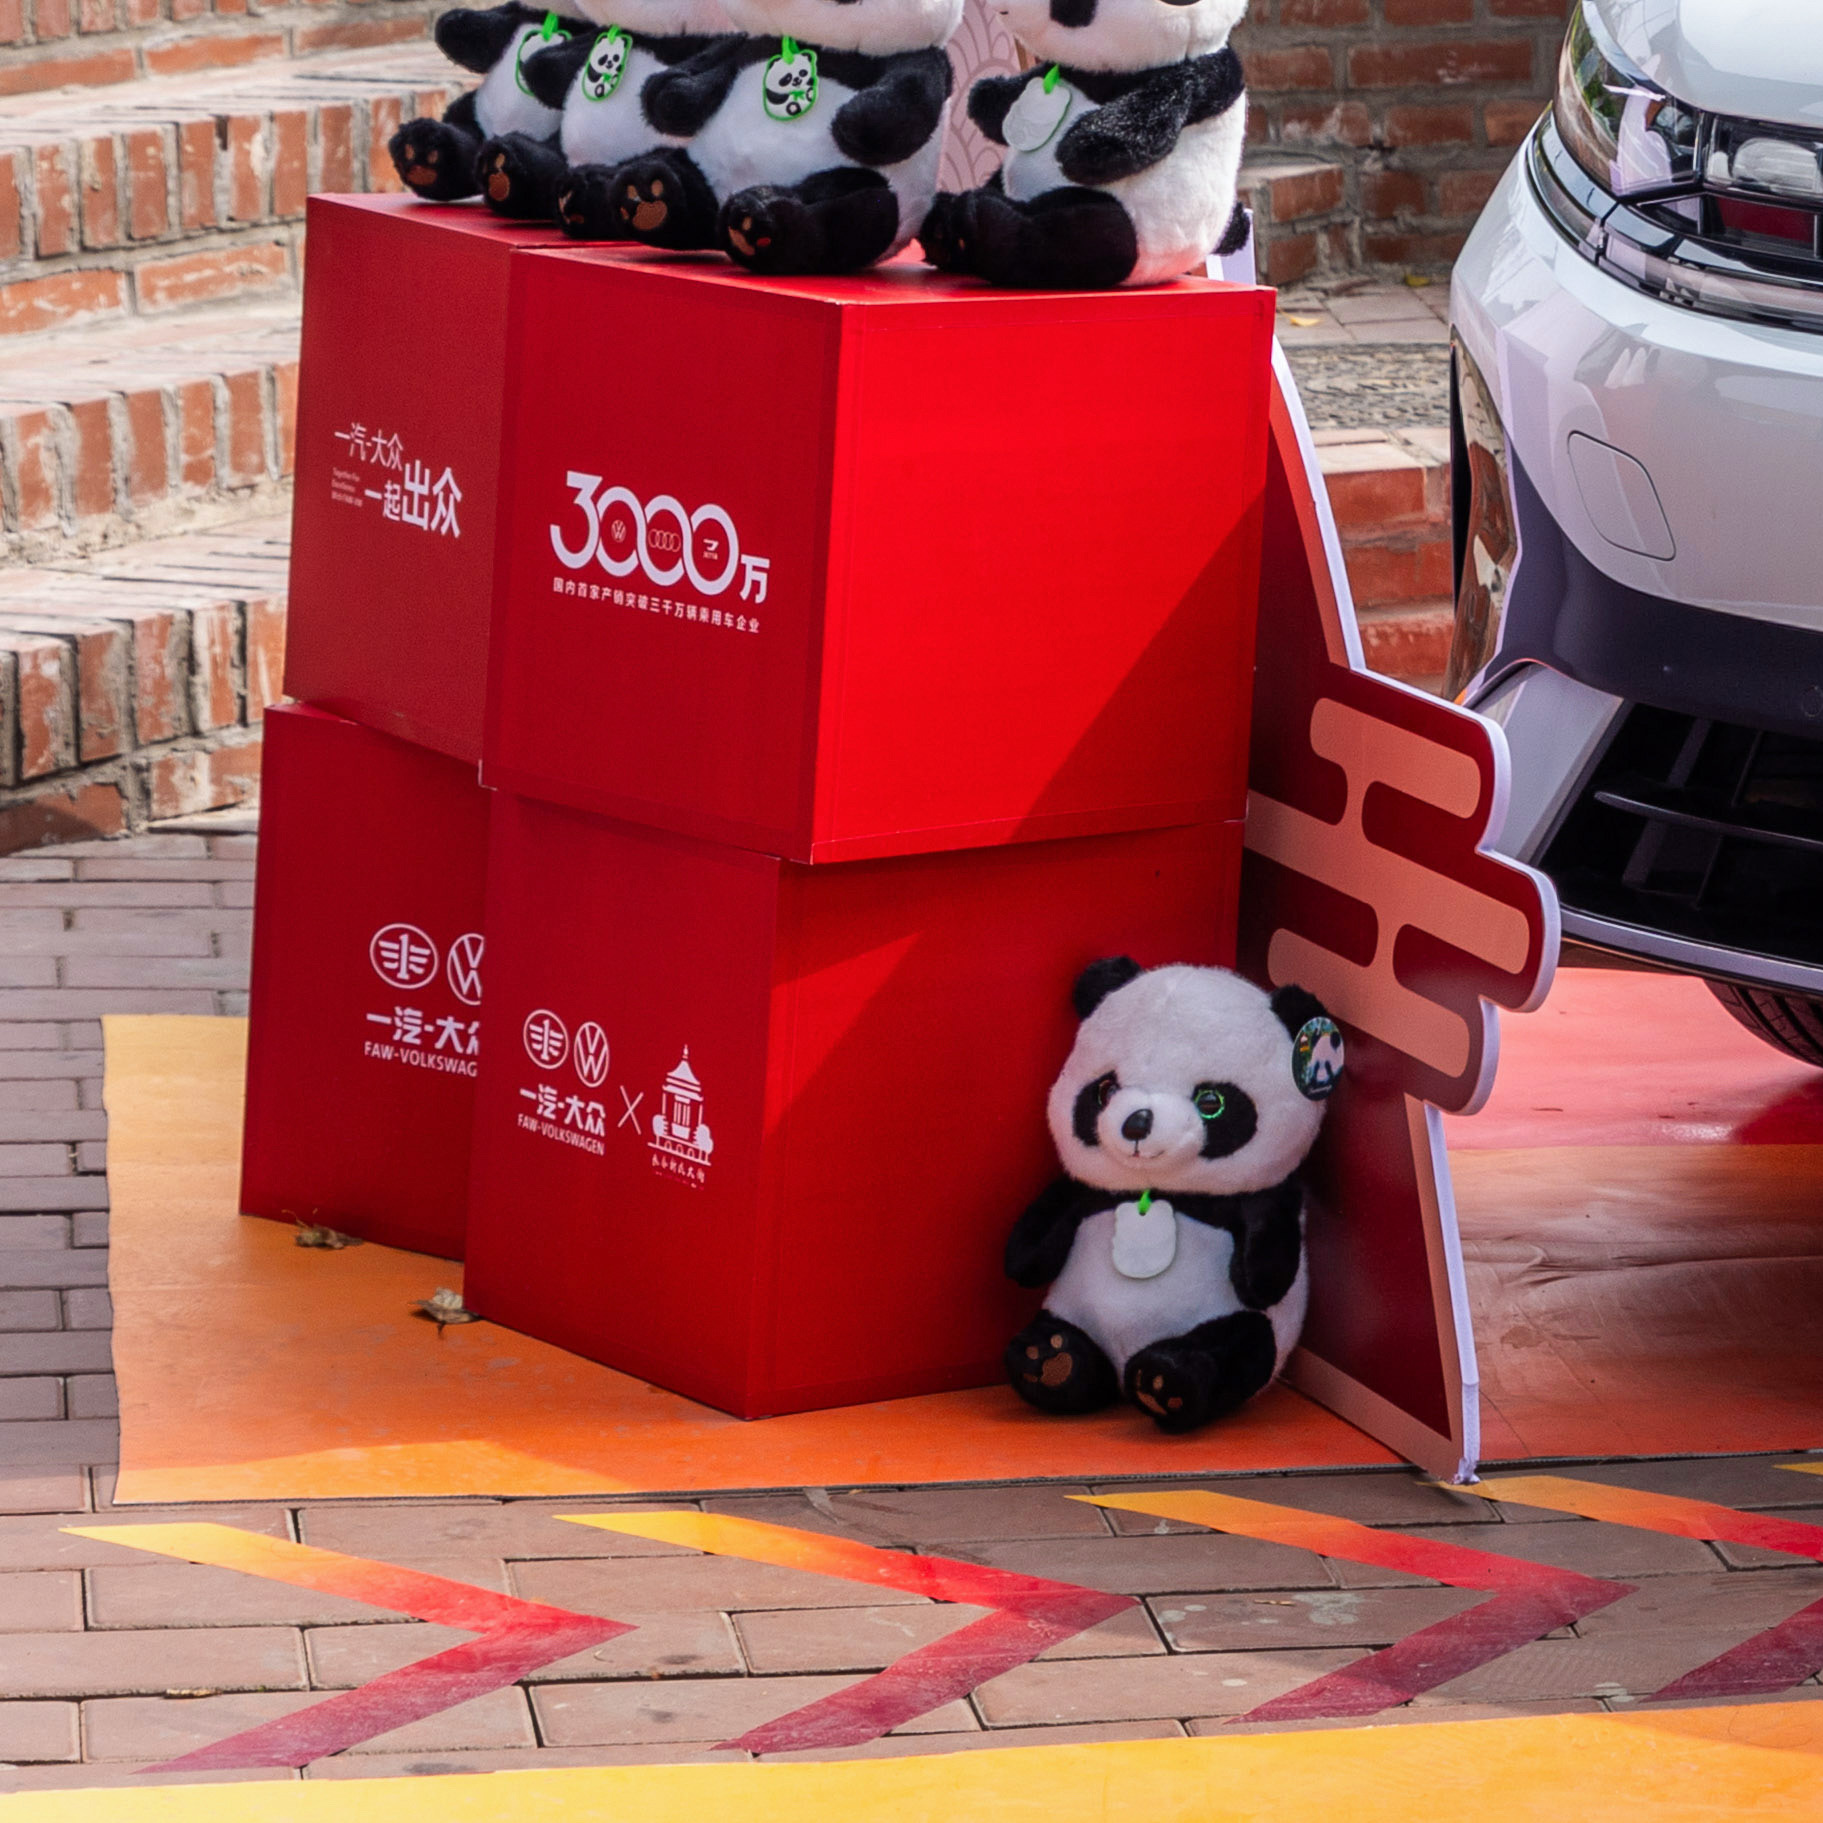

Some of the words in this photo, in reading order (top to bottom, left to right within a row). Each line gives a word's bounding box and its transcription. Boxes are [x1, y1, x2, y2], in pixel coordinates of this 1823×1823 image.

[364, 459, 462, 538] 一起出众
[364, 1041, 478, 1077] FAW-VOLKSWAG
[517, 1113, 605, 1157] FAW-VOLKSWAGEN
